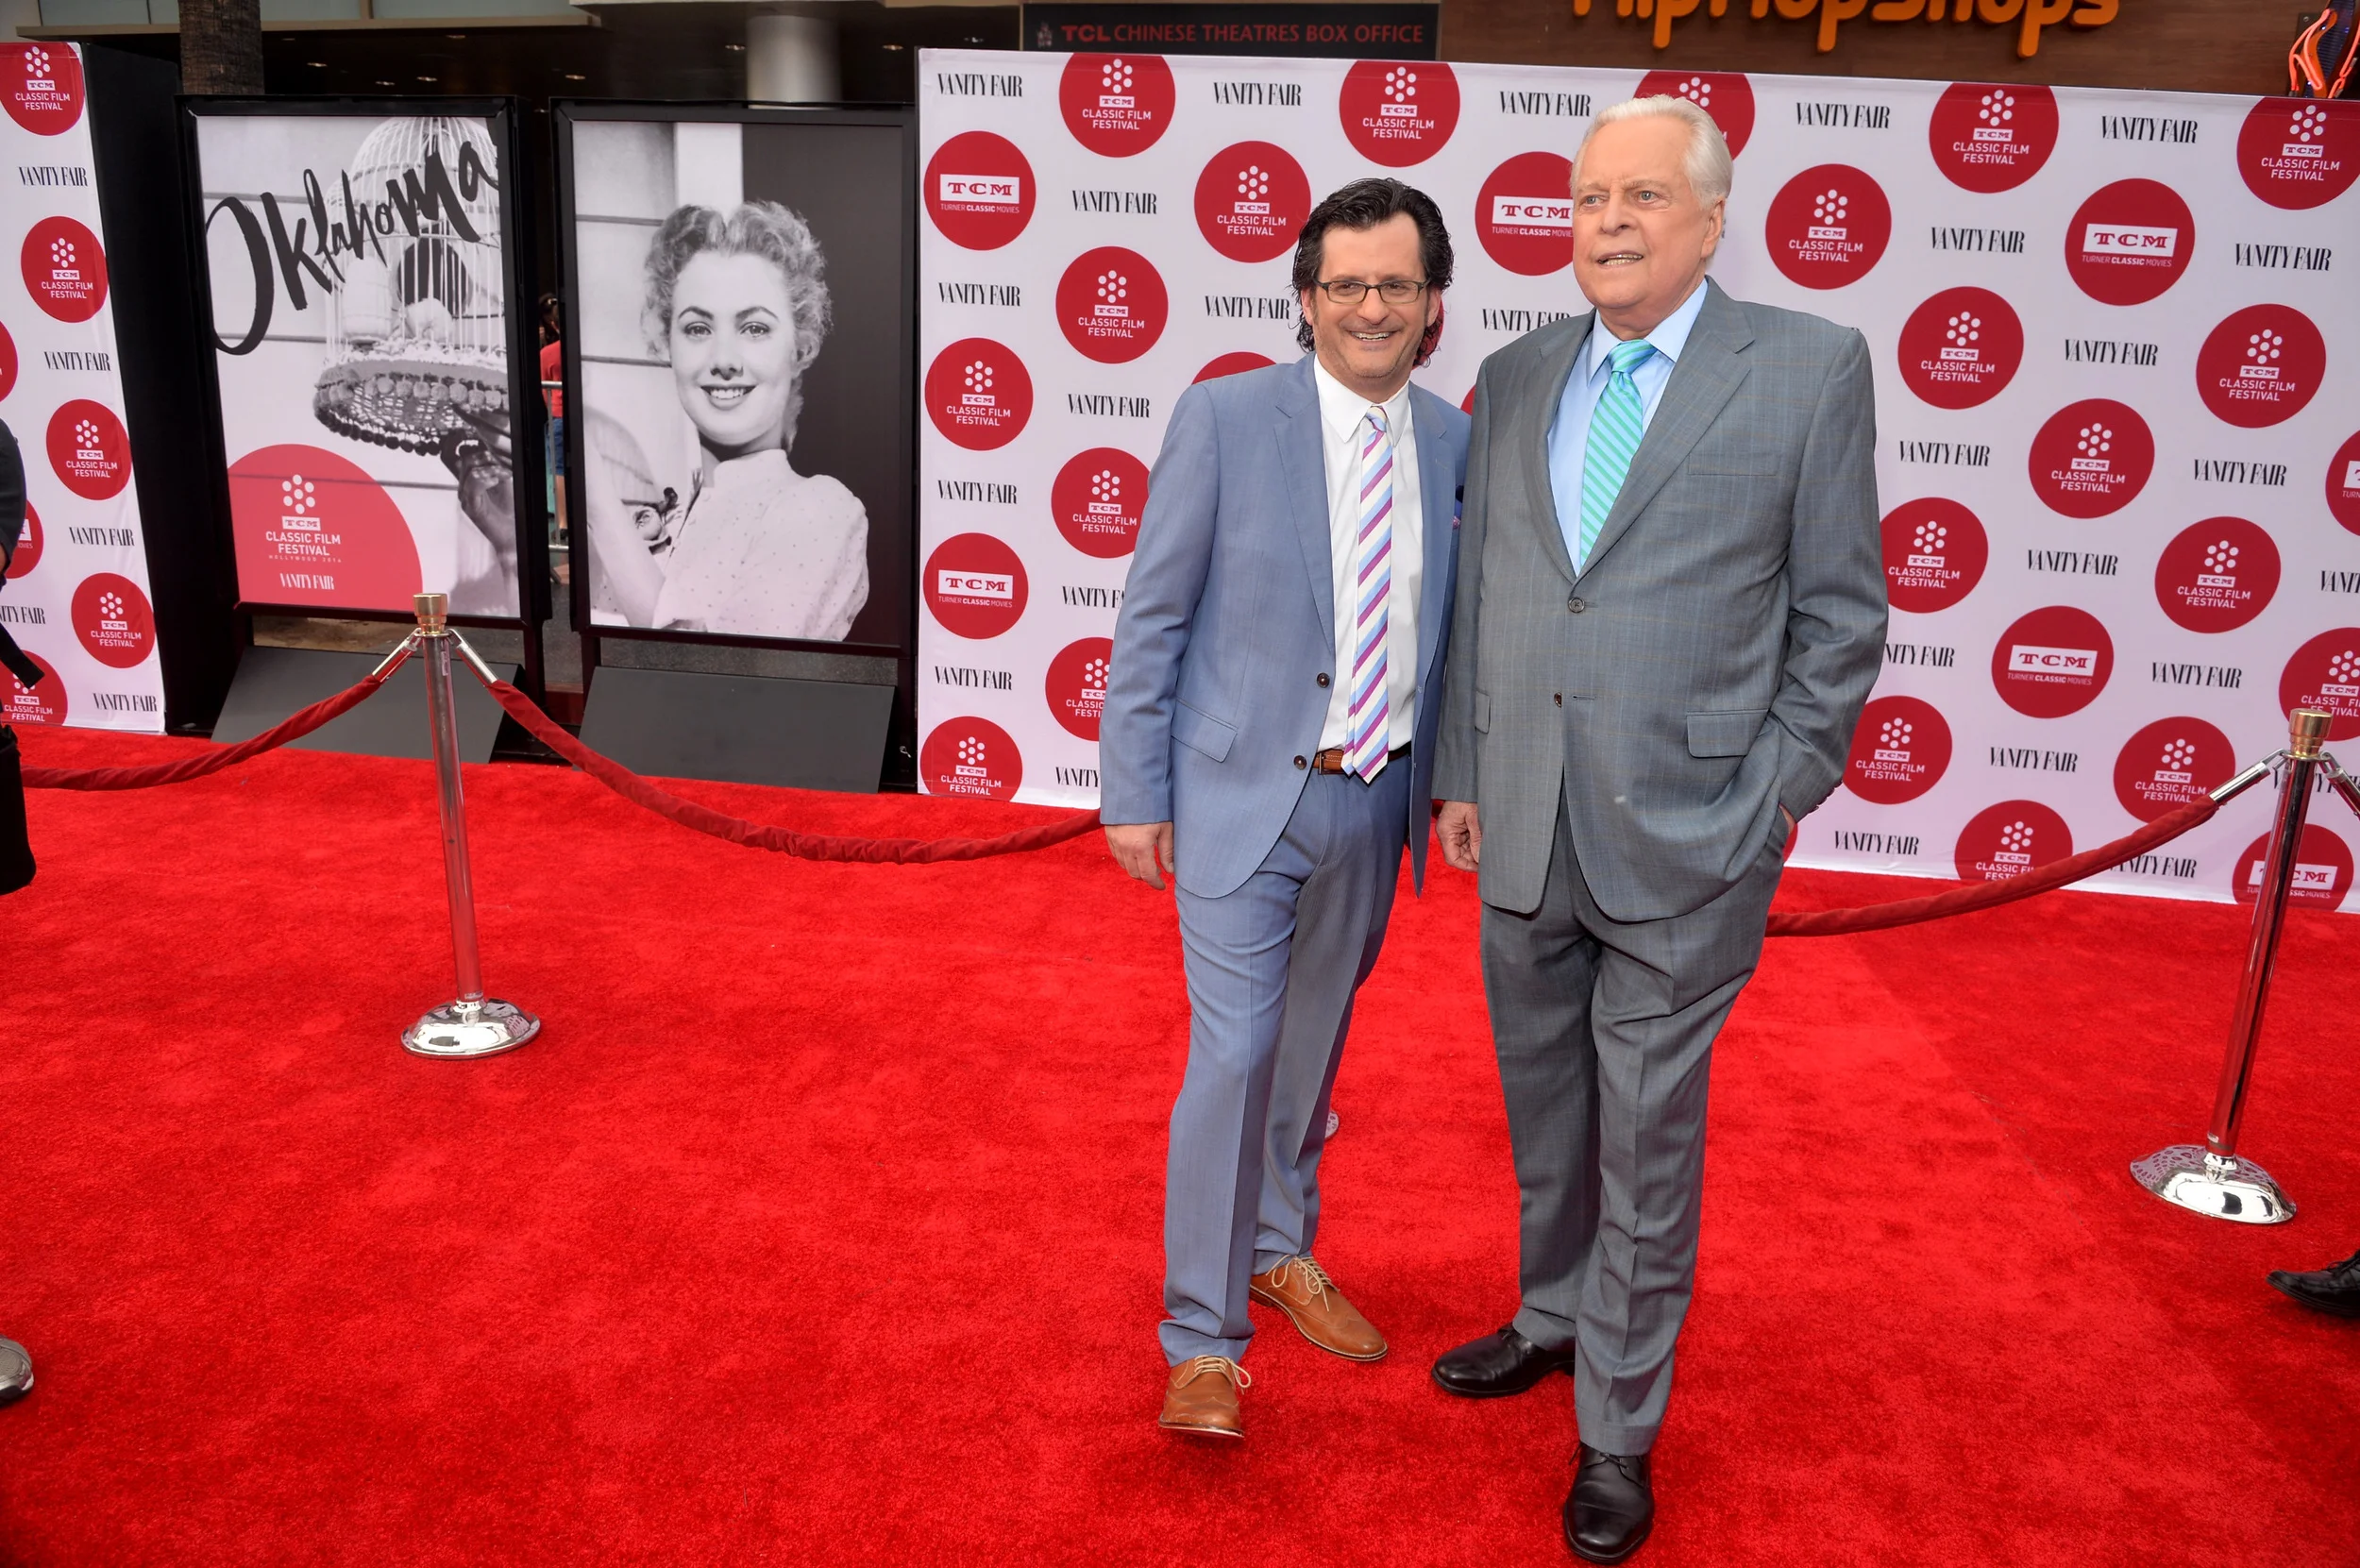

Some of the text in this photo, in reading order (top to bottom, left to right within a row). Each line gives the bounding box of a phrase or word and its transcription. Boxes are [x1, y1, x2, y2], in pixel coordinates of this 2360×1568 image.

[1061, 24, 1423, 43] TCL CHINESE THEATRES BOX OFFICE
[937, 74, 1022, 97] VANITY FAIR
[15, 93, 70, 101] CLASSIC FILM
[1214, 82, 1301, 106] VANITY FAIR
[25, 102, 63, 110] FESTIVAL
[1500, 92, 1591, 117] VANITY FAIR
[1082, 109, 1152, 120] CLASSIC FILM
[1796, 103, 1890, 128] VANITY FAIR
[1092, 119, 1139, 130] FESTIVAL
[1362, 117, 1434, 129] CLASSIC FILM
[2102, 116, 2198, 143] VANITY FAIR
[1373, 128, 1422, 140] FESTIVAL
[1953, 142, 2030, 154] CLASSIC FILM
[2285, 146, 2320, 155] TCM
[1963, 153, 2014, 164] FESTIVAL
[2261, 158, 2340, 171] CLASSIC FILM
[19, 166, 88, 186] VANITY FAIR
[2271, 169, 2324, 181] FESTIVAL
[948, 182, 1012, 196] TCM
[966, 204, 995, 212] CLASSIC
[1072, 190, 1156, 214] VANITY FAIR
[1501, 205, 1571, 219] TCM
[1217, 214, 1286, 226] CLASSIC FILM
[1227, 225, 1274, 236] FESTIVAL
[1931, 227, 2025, 253] VANITY FAIR
[2094, 230, 2167, 248] TCM
[1789, 240, 1863, 252] CLASSIC FILM
[1798, 250, 1849, 262] FESTIVAL
[2111, 257, 2145, 265] CLASSIC
[2147, 257, 2171, 266] MOVIES
[2236, 244, 2332, 271] VANITY FAIR
[42, 281, 93, 290] CLASSIC FILM
[50, 290, 87, 299] FESTIVAL
[938, 282, 1020, 307] VANITY FAIR
[1205, 295, 1290, 320] VANITY FAIR
[1078, 317, 1144, 329] CLASSIC FILM
[1088, 327, 1134, 338] FESTIVAL
[2065, 339, 2158, 366] VANITY FAIR
[44, 351, 110, 371] VANITY FAIR
[1921, 361, 1995, 373] CLASSIC FILM
[1930, 371, 1981, 382] FESTIVAL
[2241, 368, 2277, 378] TCM
[2219, 378, 2296, 392] CLASSIC FILM
[2229, 389, 2280, 401] FESTIVAL
[947, 405, 1011, 417] CLASSIC FILM
[1068, 394, 1150, 418] VANITY FAIR
[956, 415, 1000, 426] FESTIVAL
[1900, 441, 1990, 466] VANITY FAIR
[66, 461, 98, 469] CLASSIC
[75, 469, 110, 478] FESTIVAL
[2051, 470, 2125, 483] CLASSIC FILM
[2195, 459, 2286, 486] VANITY FAIR
[938, 480, 1017, 504] VANITY FAIR
[2061, 481, 2111, 493] FESTIVAL
[285, 519, 317, 528] TCM
[1072, 514, 1137, 526] CLASSIC FILM
[1082, 523, 1126, 534] FESTIVAL
[69, 527, 134, 546] VANITY FAIR
[265, 531, 341, 545] CLASSIC FILM
[278, 543, 329, 556] FESTIVAL
[2029, 549, 2118, 576] VANITY FAIR
[1888, 566, 1960, 580] CLASSIC FILM
[279, 573, 334, 590] VANITY FAIR
[945, 578, 1006, 592] TCM
[1897, 577, 1946, 588] FESTIVAL
[2177, 586, 2250, 599] CLASSIC FILM
[2186, 597, 2235, 609] FESTIVAL
[101, 621, 127, 630] TCM
[91, 631, 122, 639] CLASSIC
[99, 638, 135, 648] FESTIVAL
[2019, 653, 2090, 668] TCM
[935, 666, 1012, 690] VANITY FAIR
[2152, 662, 2242, 688] VANITY FAIR
[93, 693, 157, 712] VANITY FAIR
[1991, 747, 2078, 772] VANITY FAIR
[1856, 760, 1925, 773] CLASSIC FILM
[941, 775, 1002, 788] CLASSIC FILM
[1864, 769, 1913, 782] FESTIVAL
[950, 784, 991, 796] FESTIVAL
[1835, 831, 1919, 855] VANITY FAIR
